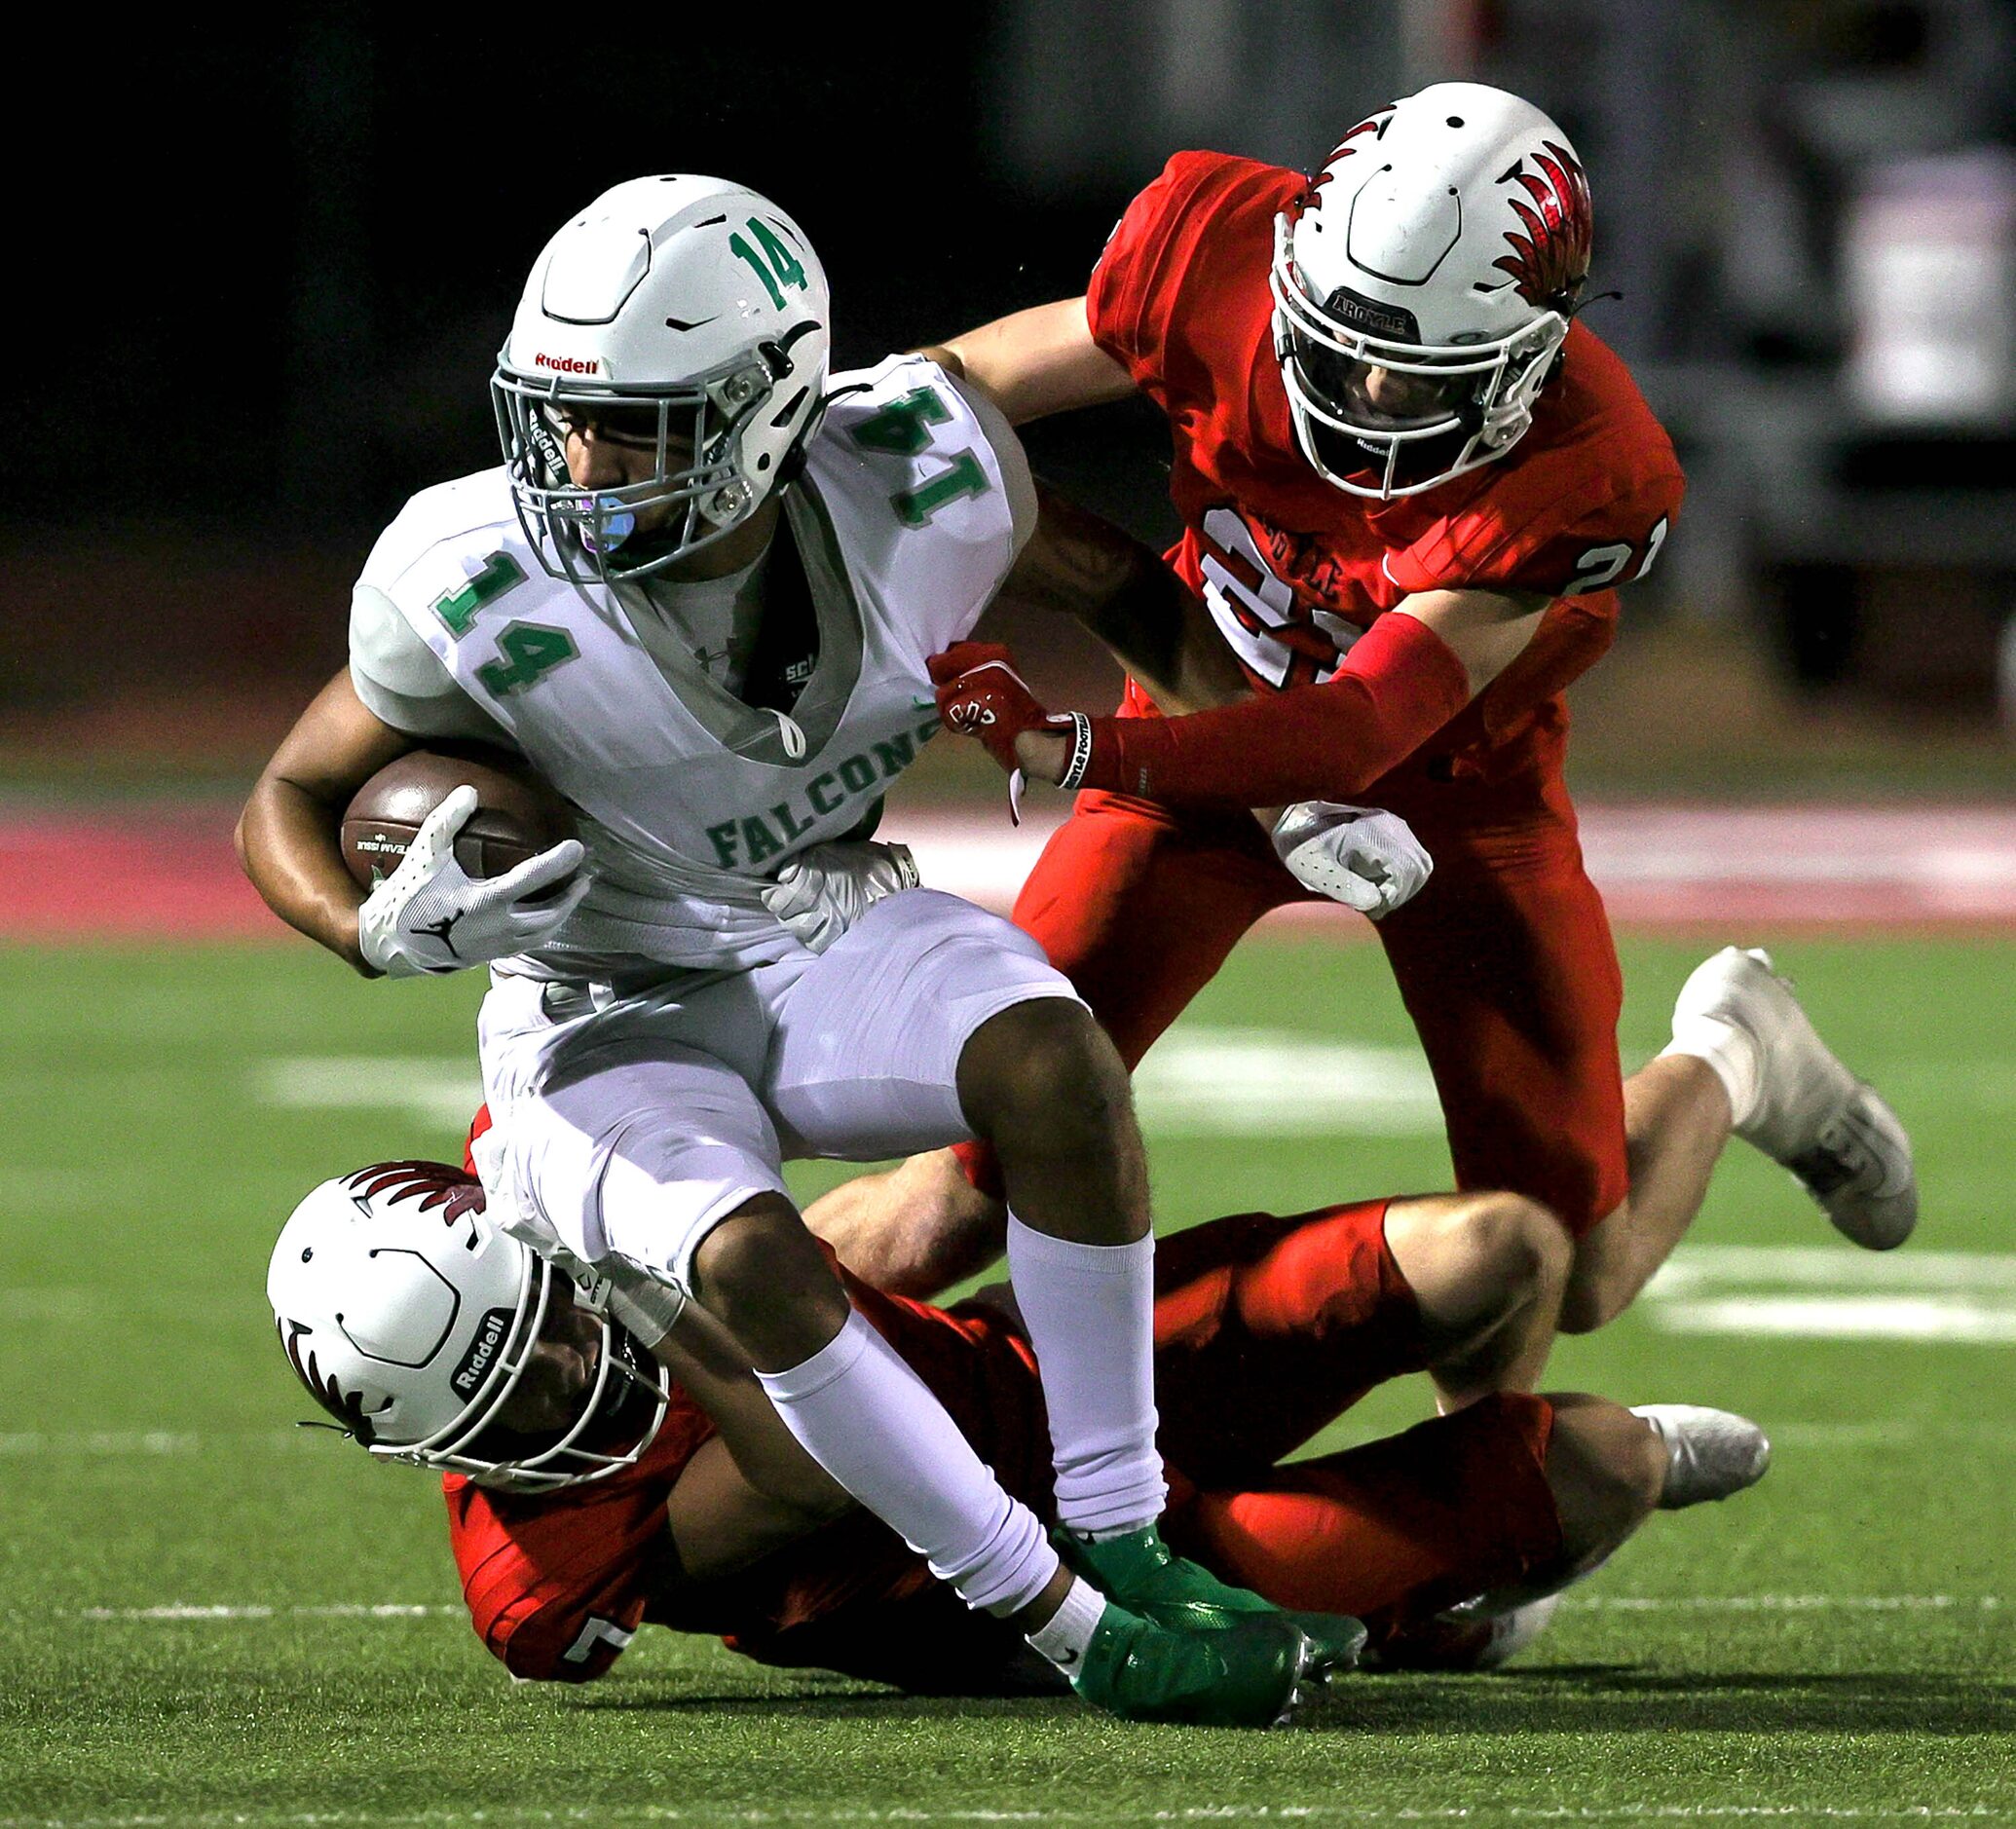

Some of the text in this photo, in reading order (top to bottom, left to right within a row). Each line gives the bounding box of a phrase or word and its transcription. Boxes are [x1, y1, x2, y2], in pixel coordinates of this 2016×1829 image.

[728, 216, 808, 312] 14
[535, 353, 600, 375] Riddell
[842, 384, 992, 531] 14
[1356, 437, 1391, 457] Riddel
[1560, 517, 1667, 597] 21
[428, 550, 581, 697] 14
[456, 1315, 504, 1390] Riddell
